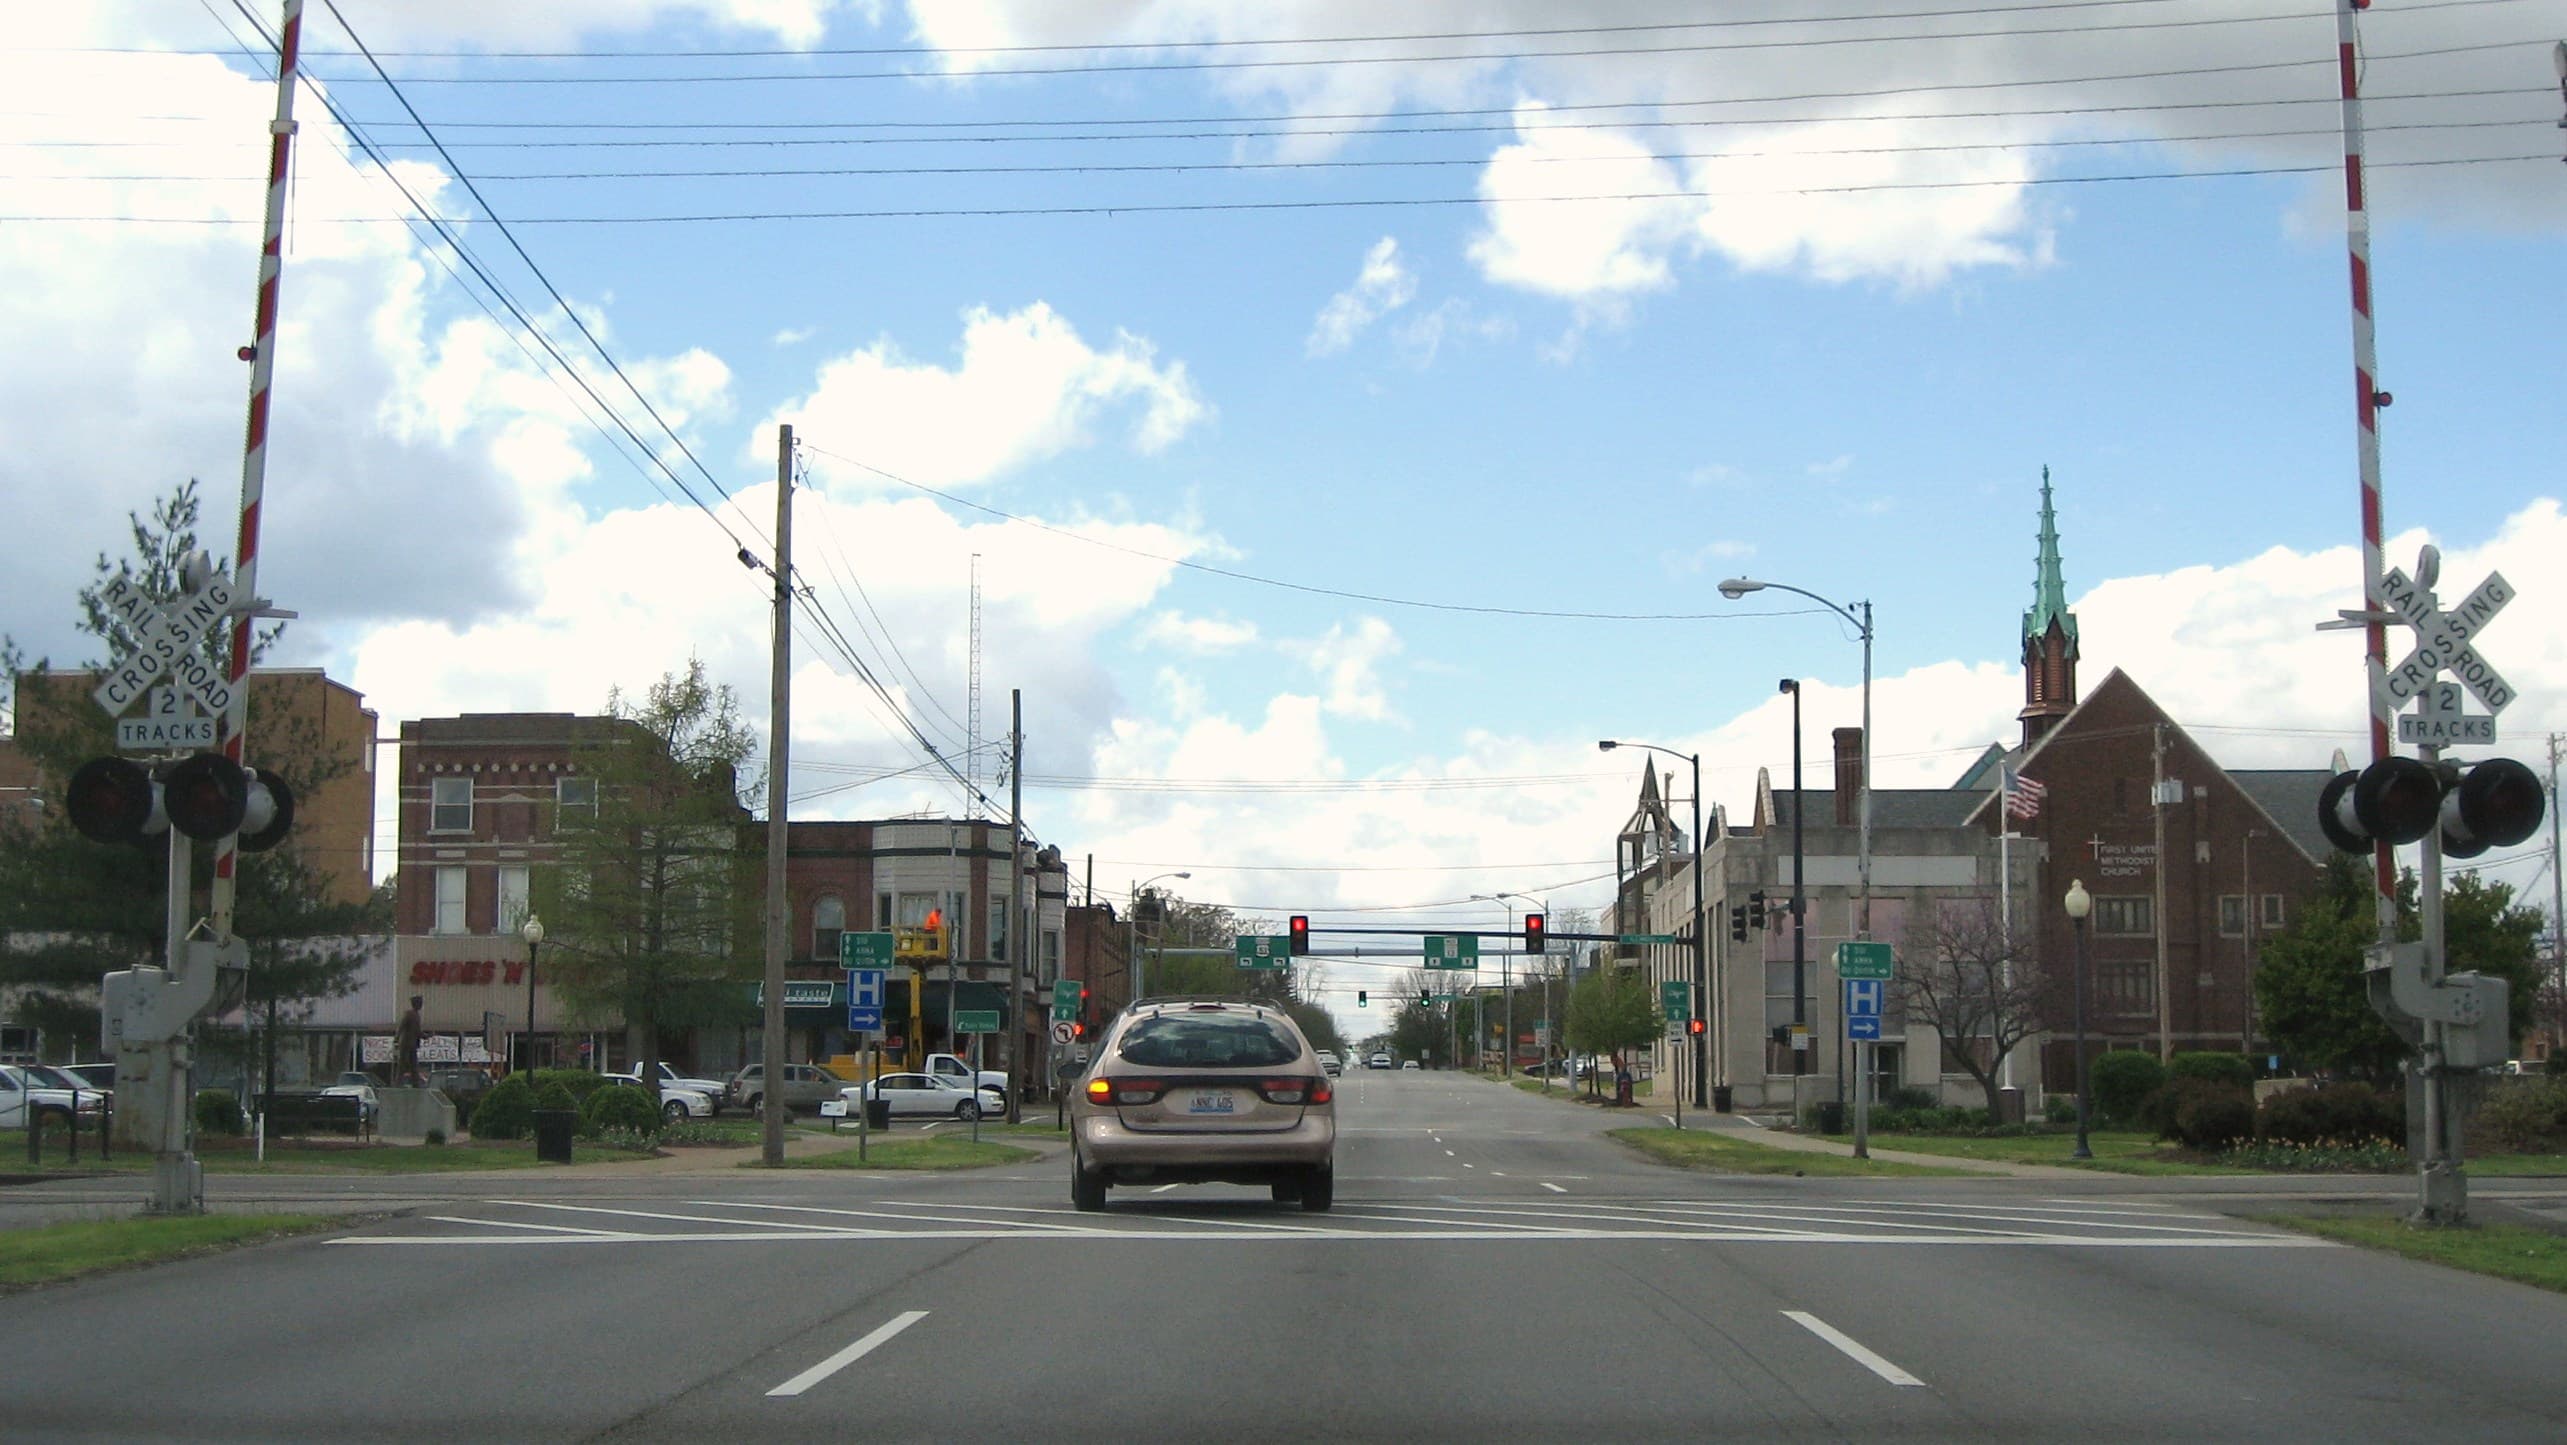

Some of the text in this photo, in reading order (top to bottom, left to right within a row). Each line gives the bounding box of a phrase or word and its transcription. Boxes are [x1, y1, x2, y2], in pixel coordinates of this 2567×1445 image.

[106, 578, 231, 711] RAIL ROAD
[107, 584, 231, 704] CROSSING
[2382, 574, 2508, 709] RAIL ROAD
[2389, 582, 2506, 698] CROSSING
[160, 693, 176, 715] 2
[2440, 689, 2455, 711] 2
[123, 722, 213, 741] TRACKS
[2403, 720, 2492, 738] TRACKS
[2100, 845, 2160, 854] FIRST UNITE
[2100, 856, 2155, 865] METHODIST
[2100, 867, 2142, 876] CHURCH
[410, 961, 496, 985] SHOES
[853, 971, 880, 1005] H
[1850, 981, 1878, 1014] H
